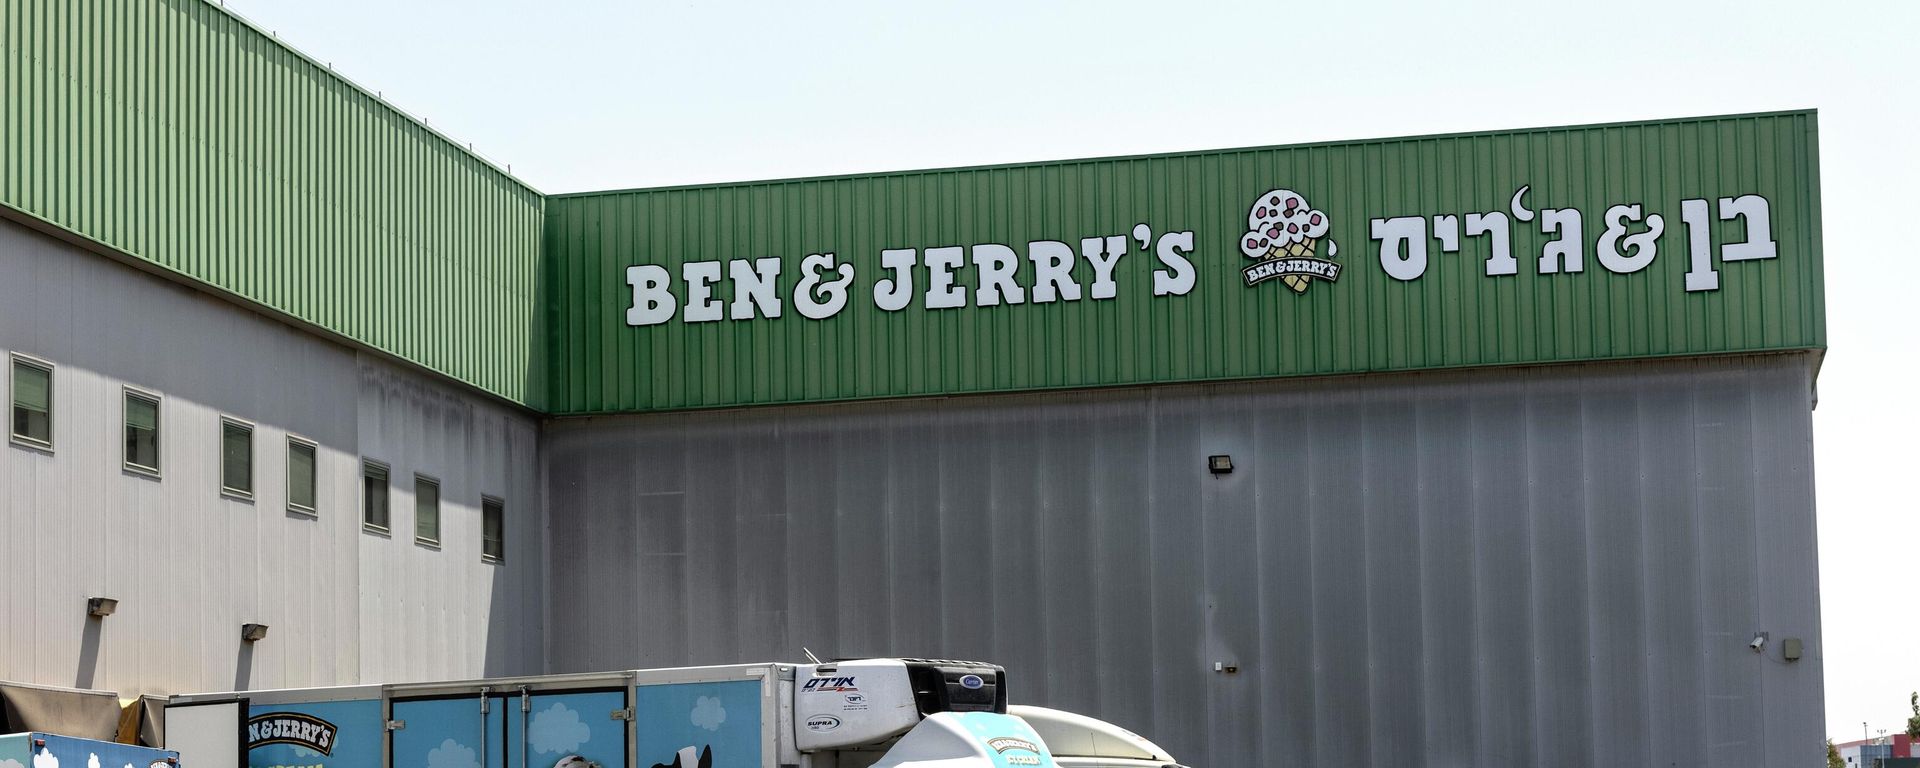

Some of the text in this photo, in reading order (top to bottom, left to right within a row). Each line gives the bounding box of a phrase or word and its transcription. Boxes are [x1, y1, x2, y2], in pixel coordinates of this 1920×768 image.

[626, 223, 1197, 326] BEN & JERRY'S
[1596, 203, 1665, 274] &
[1680, 193, 1777, 293] בן
